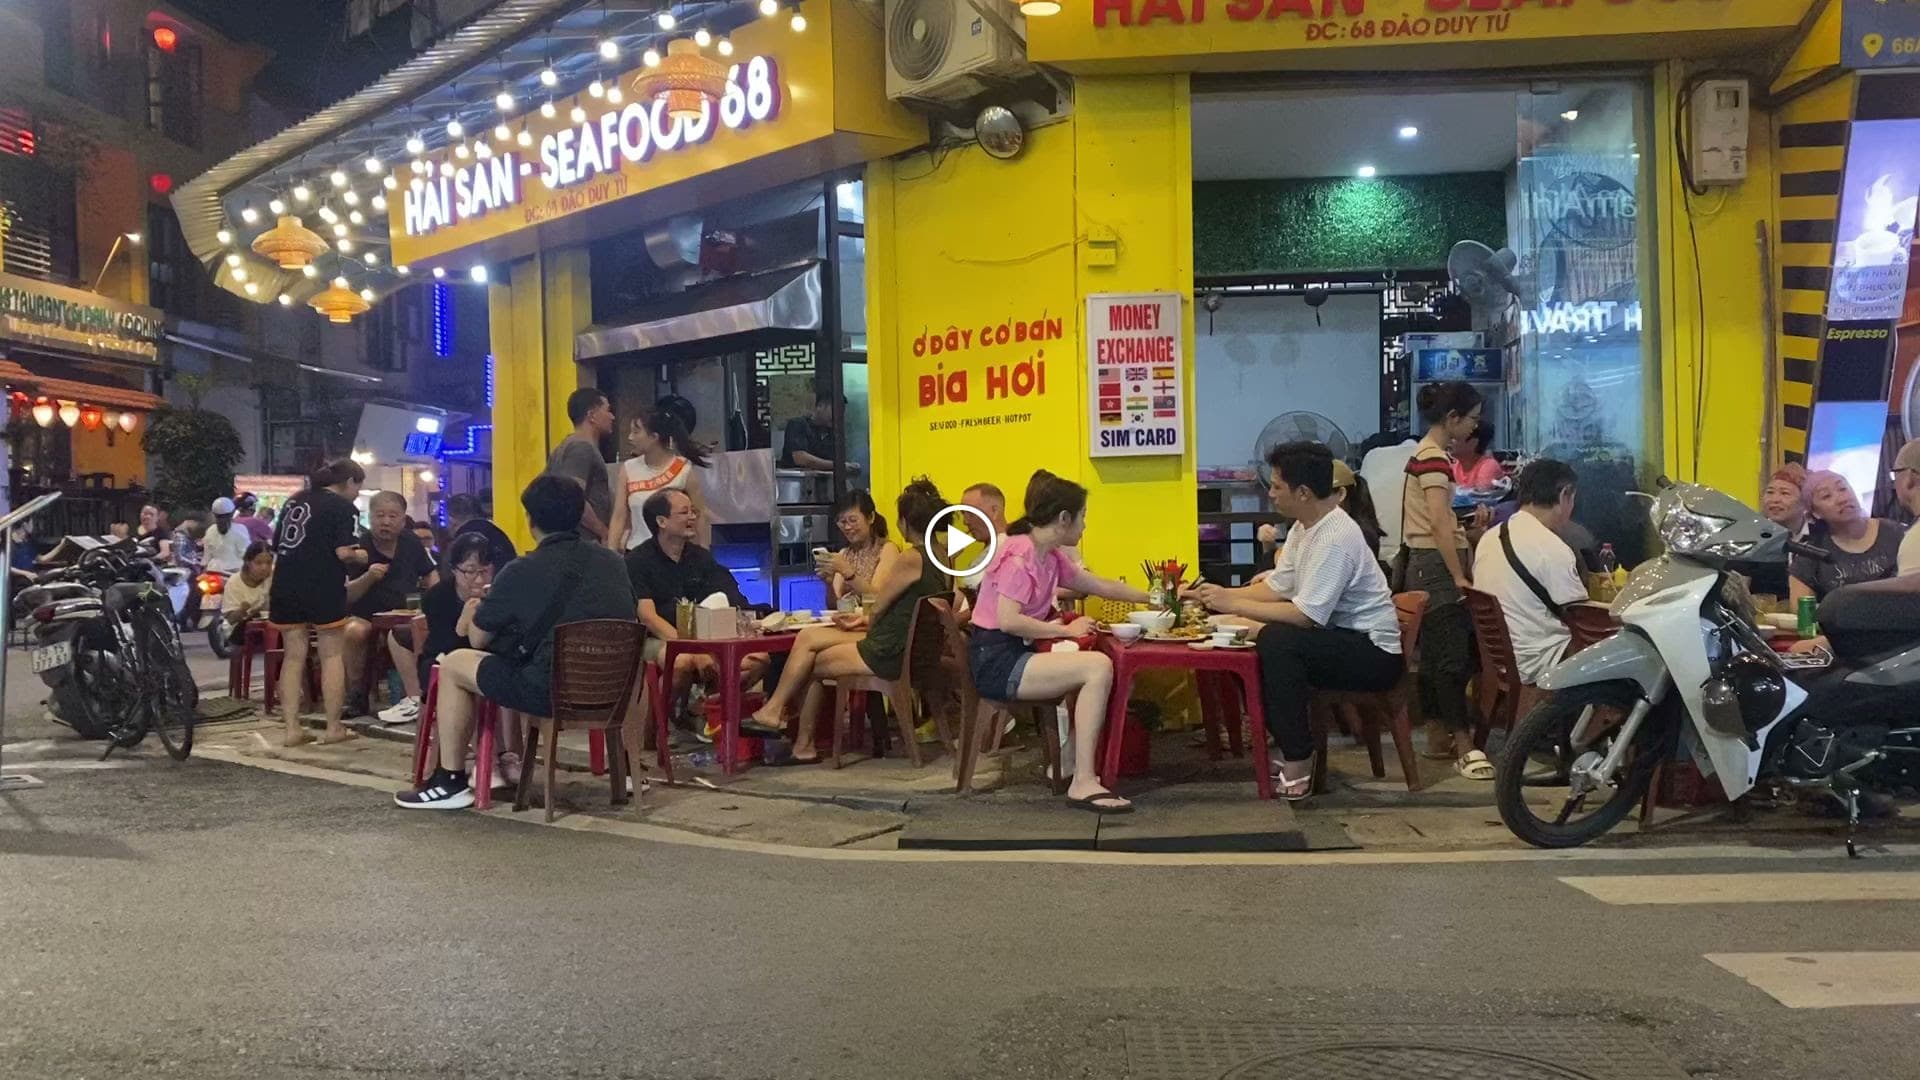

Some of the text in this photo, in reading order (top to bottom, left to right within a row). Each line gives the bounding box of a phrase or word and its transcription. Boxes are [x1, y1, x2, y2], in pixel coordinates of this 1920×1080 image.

[1350, 20, 1376, 38] 68
[1434, 15, 1478, 35] DUY
[541, 100, 711, 188] SEAFOOD
[720, 55, 773, 128] 68
[1109, 304, 1161, 331] MONEY
[1826, 327, 1888, 341] Espresso
[1097, 336, 1174, 364] EXCHANGE
[1101, 427, 1176, 447] SIM CARD
